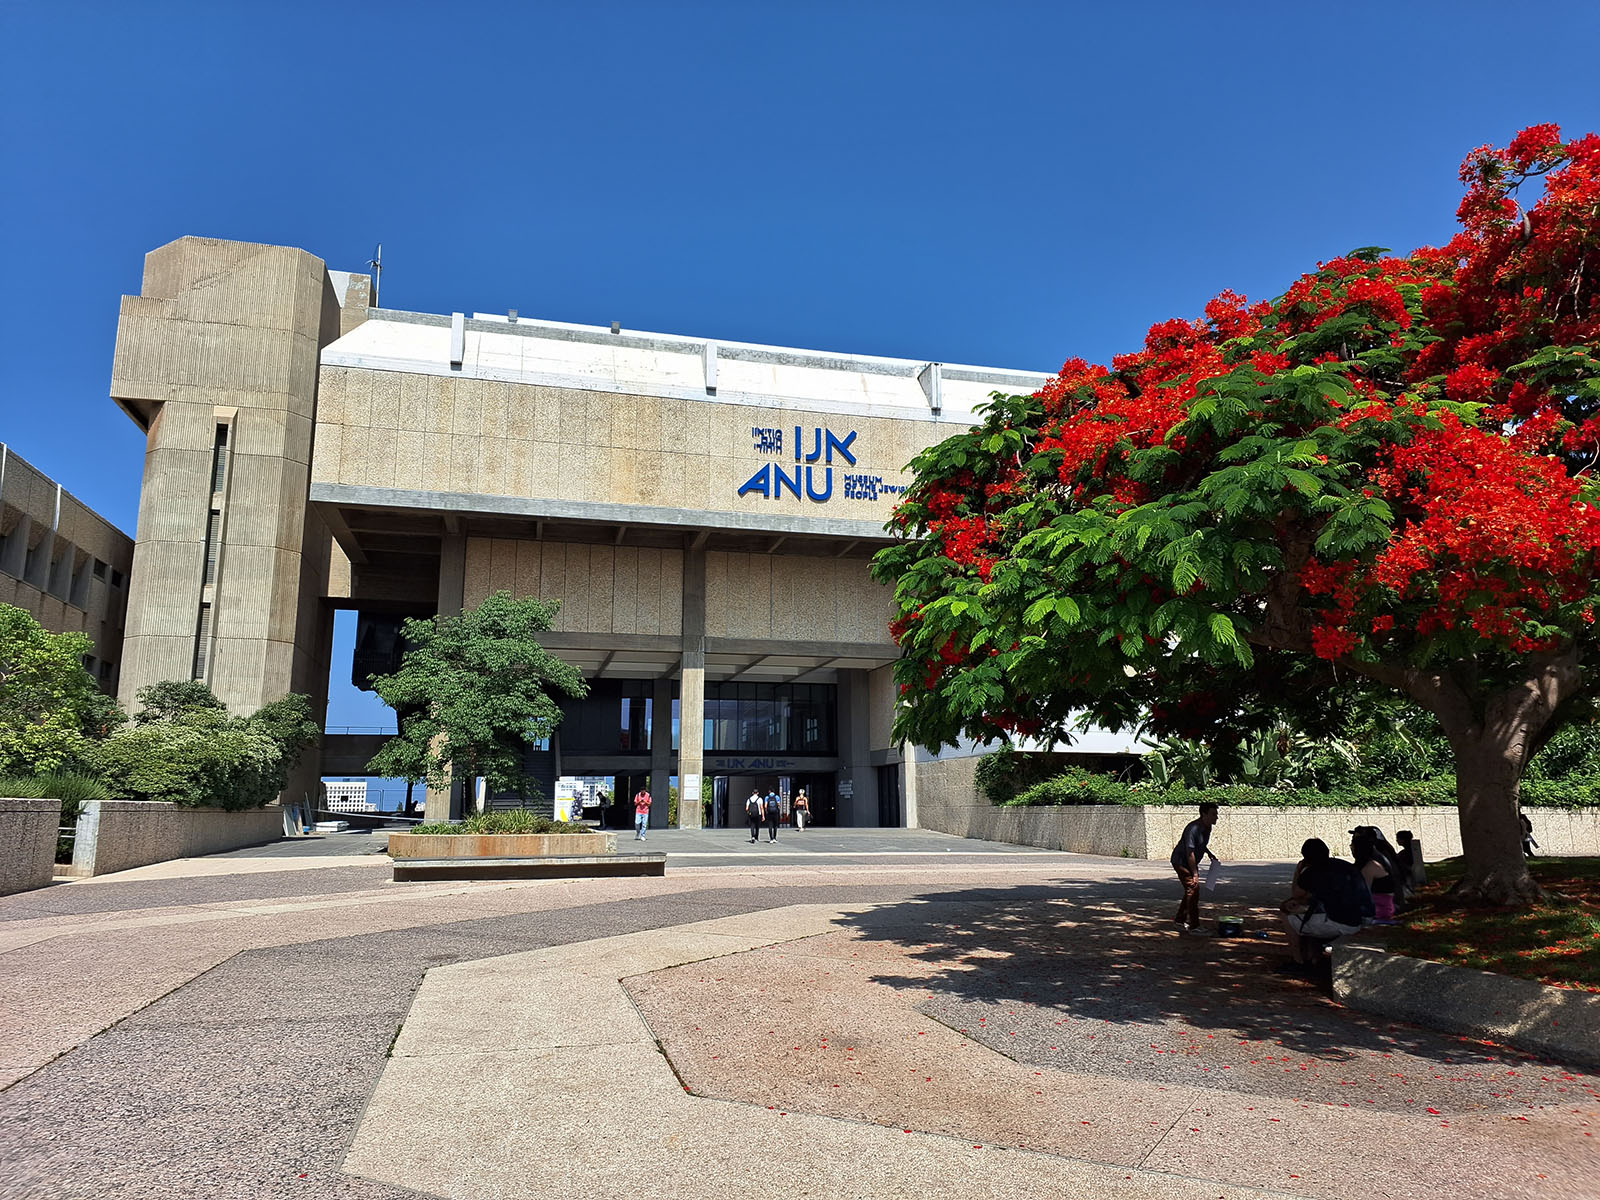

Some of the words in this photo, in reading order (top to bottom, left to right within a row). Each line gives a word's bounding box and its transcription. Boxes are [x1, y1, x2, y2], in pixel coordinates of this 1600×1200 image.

[795, 426, 857, 465] אנו
[737, 463, 833, 502] ANU
[844, 474, 882, 484] MUSEUM
[844, 482, 857, 490] OF
[860, 483, 876, 492] THE
[879, 485, 908, 494] JEWIS
[844, 490, 878, 501] PEOPLE
[748, 758, 774, 769] ANU
